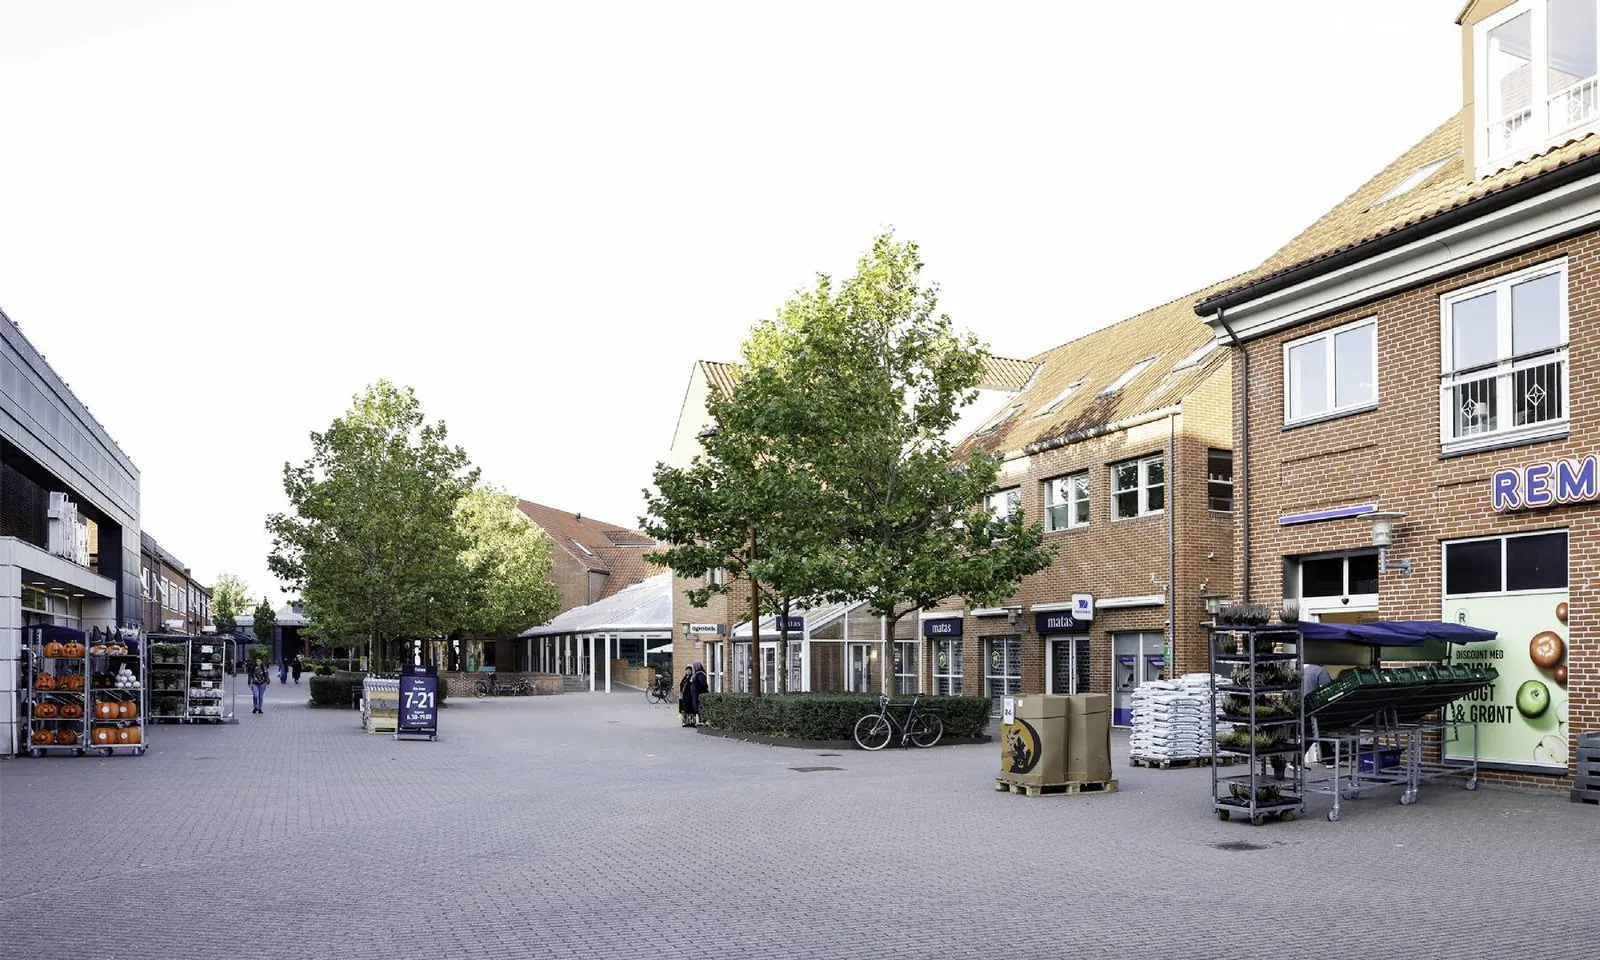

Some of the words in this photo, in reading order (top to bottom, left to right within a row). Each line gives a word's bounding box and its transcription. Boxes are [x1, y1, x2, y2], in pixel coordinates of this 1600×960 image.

[1490, 455, 1598, 511] REM
[932, 623, 952, 633] matas
[1047, 616, 1074, 628] matas
[1456, 650, 1488, 660] DISCOUNT
[1489, 650, 1504, 659] MED
[404, 692, 434, 709] 7-21
[1460, 683, 1496, 702] UGT
[1456, 704, 1465, 722] &
[1470, 704, 1514, 723] GRØNT
